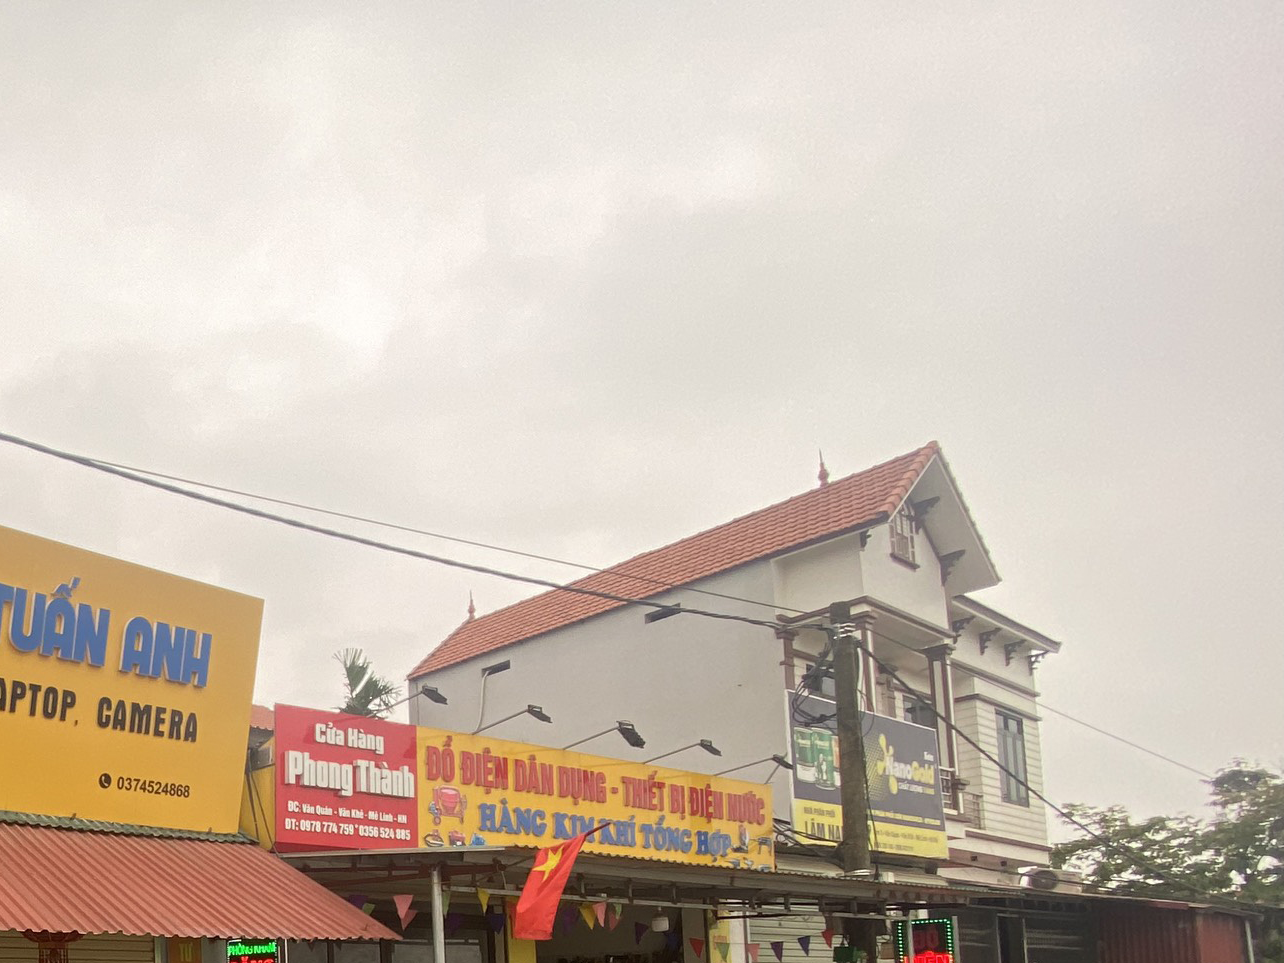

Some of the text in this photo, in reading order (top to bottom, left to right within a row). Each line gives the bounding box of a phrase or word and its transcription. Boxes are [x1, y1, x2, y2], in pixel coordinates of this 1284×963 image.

[119, 615, 213, 688] ANH
[96, 698, 198, 743] CAMERA
[315, 722, 385, 755] Cửa Hàng
[116, 777, 191, 799] 0374524868
[284, 750, 415, 798] Phong Thành
[460, 747, 508, 794] ĐIỆN
[514, 754, 554, 796] DÂN
[558, 765, 607, 805] DỤNG
[669, 783, 686, 820] BỊ
[689, 783, 724, 823] ĐIỆN
[300, 819, 321, 832] 0978
[323, 822, 337, 835] 774
[339, 823, 354, 836] 759
[359, 825, 378, 838] 0356
[379, 827, 394, 839] 524
[396, 829, 411, 840] 885
[479, 797, 547, 837] HÀNG
[552, 811, 596, 843] KIM
[598, 815, 637, 848] KHÍ
